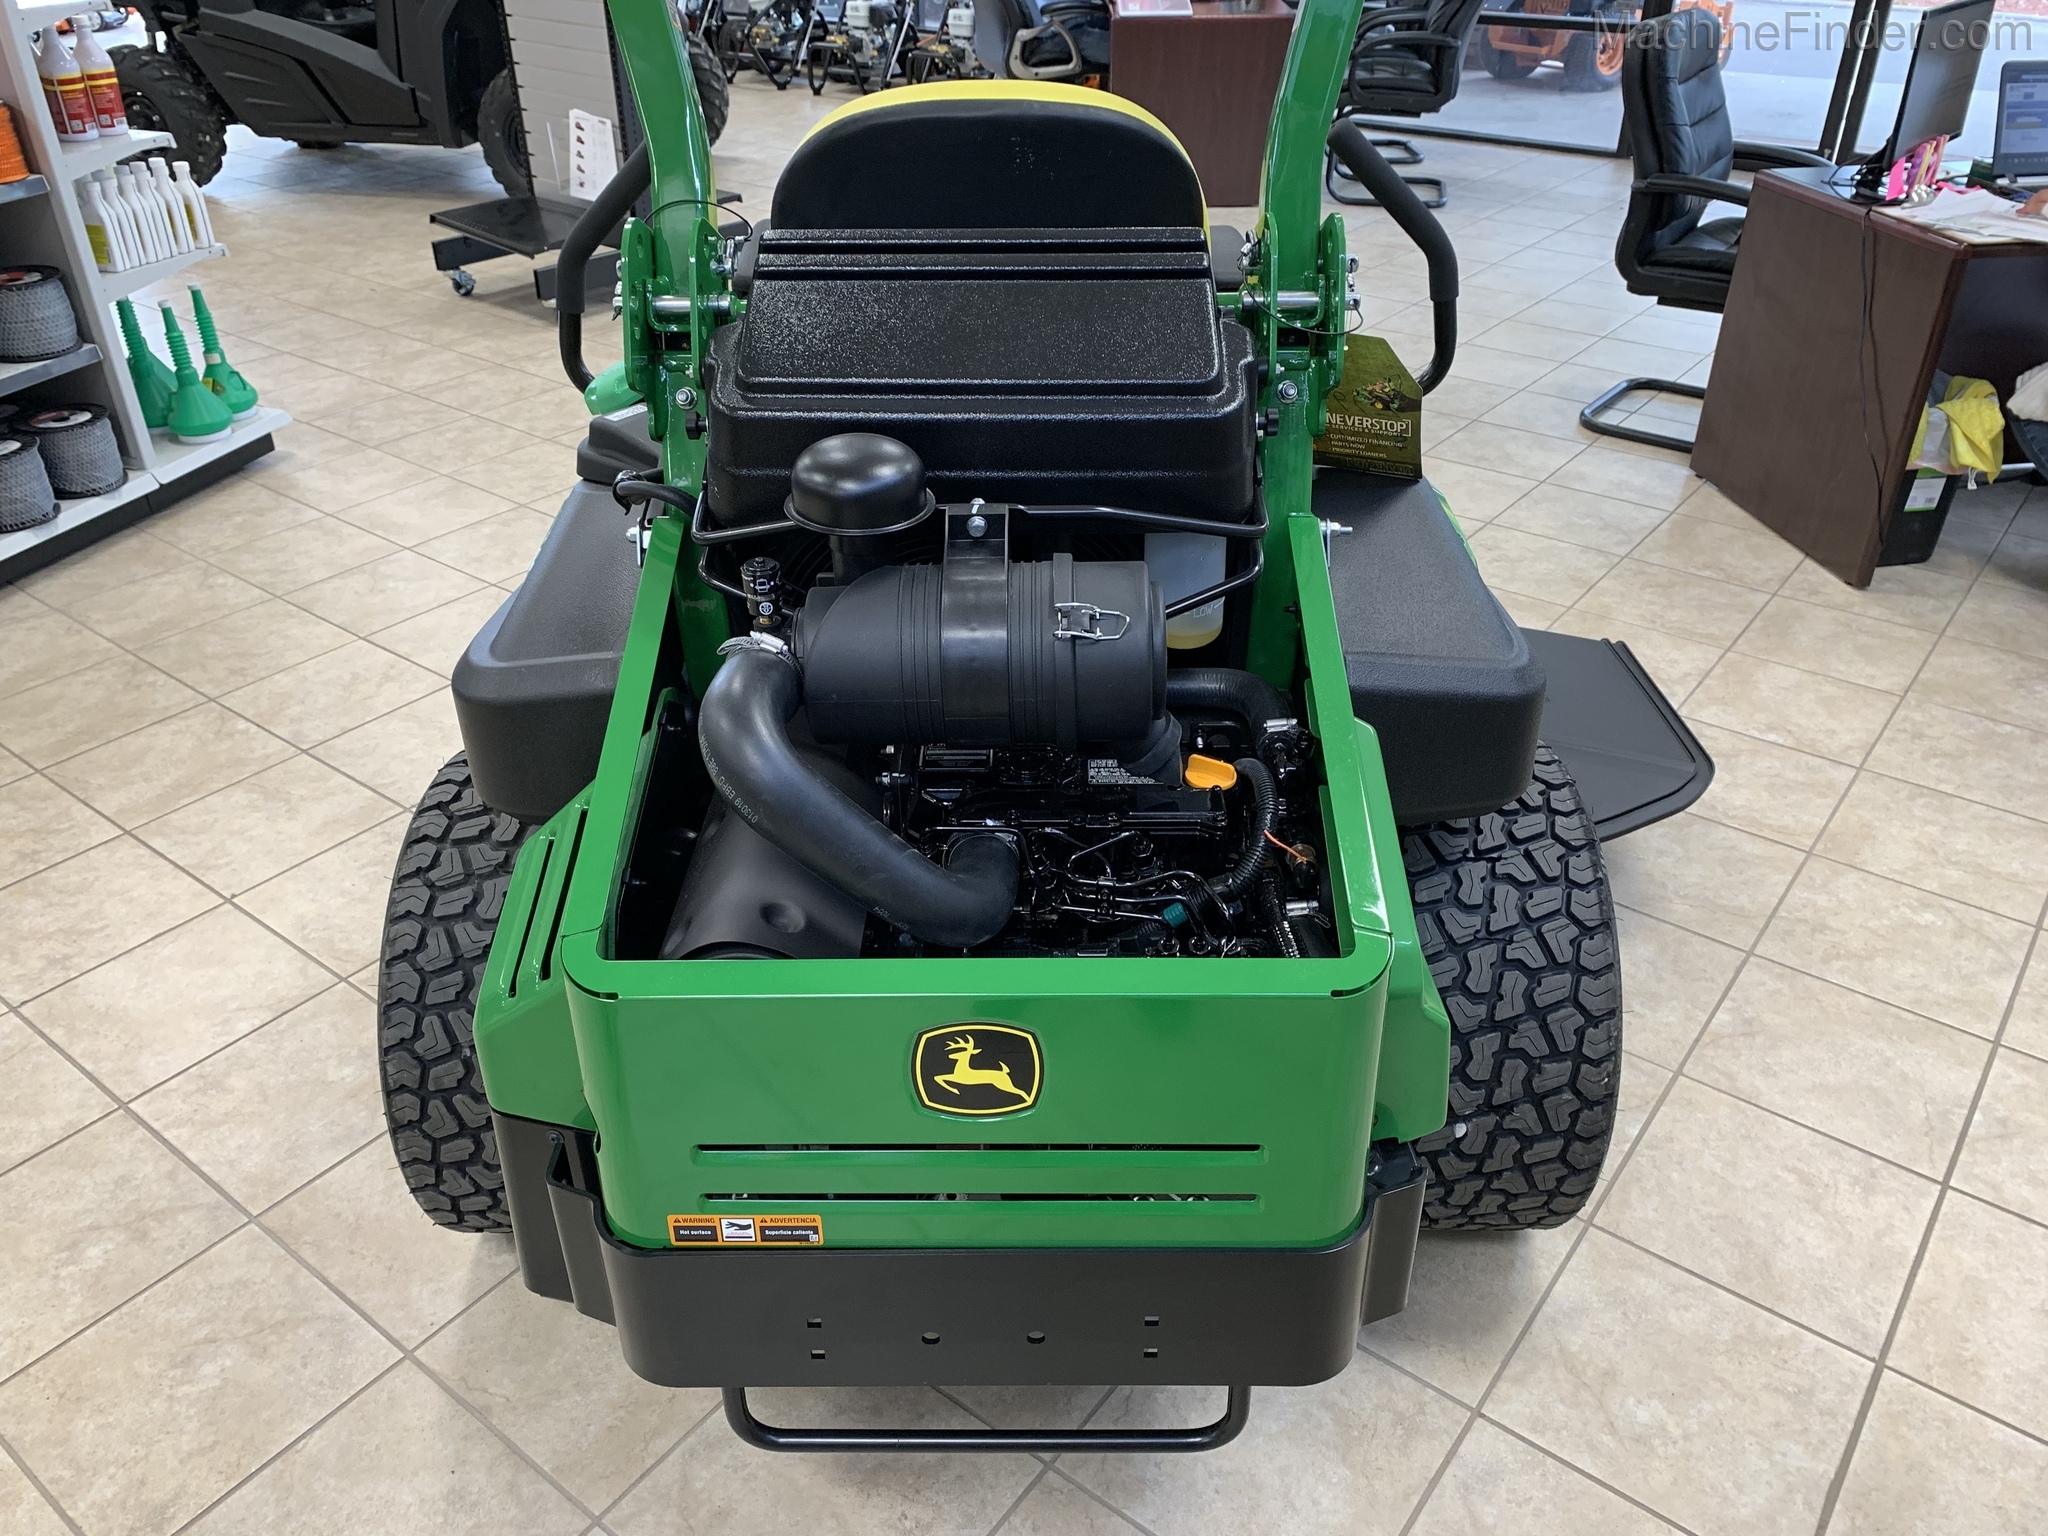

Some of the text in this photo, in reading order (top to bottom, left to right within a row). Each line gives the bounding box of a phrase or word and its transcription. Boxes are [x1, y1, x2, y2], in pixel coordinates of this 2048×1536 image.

[1326, 412, 1407, 432] NEVERSTOP
[1332, 424, 1362, 432] SERVICES
[1193, 604, 1214, 618] LOW
